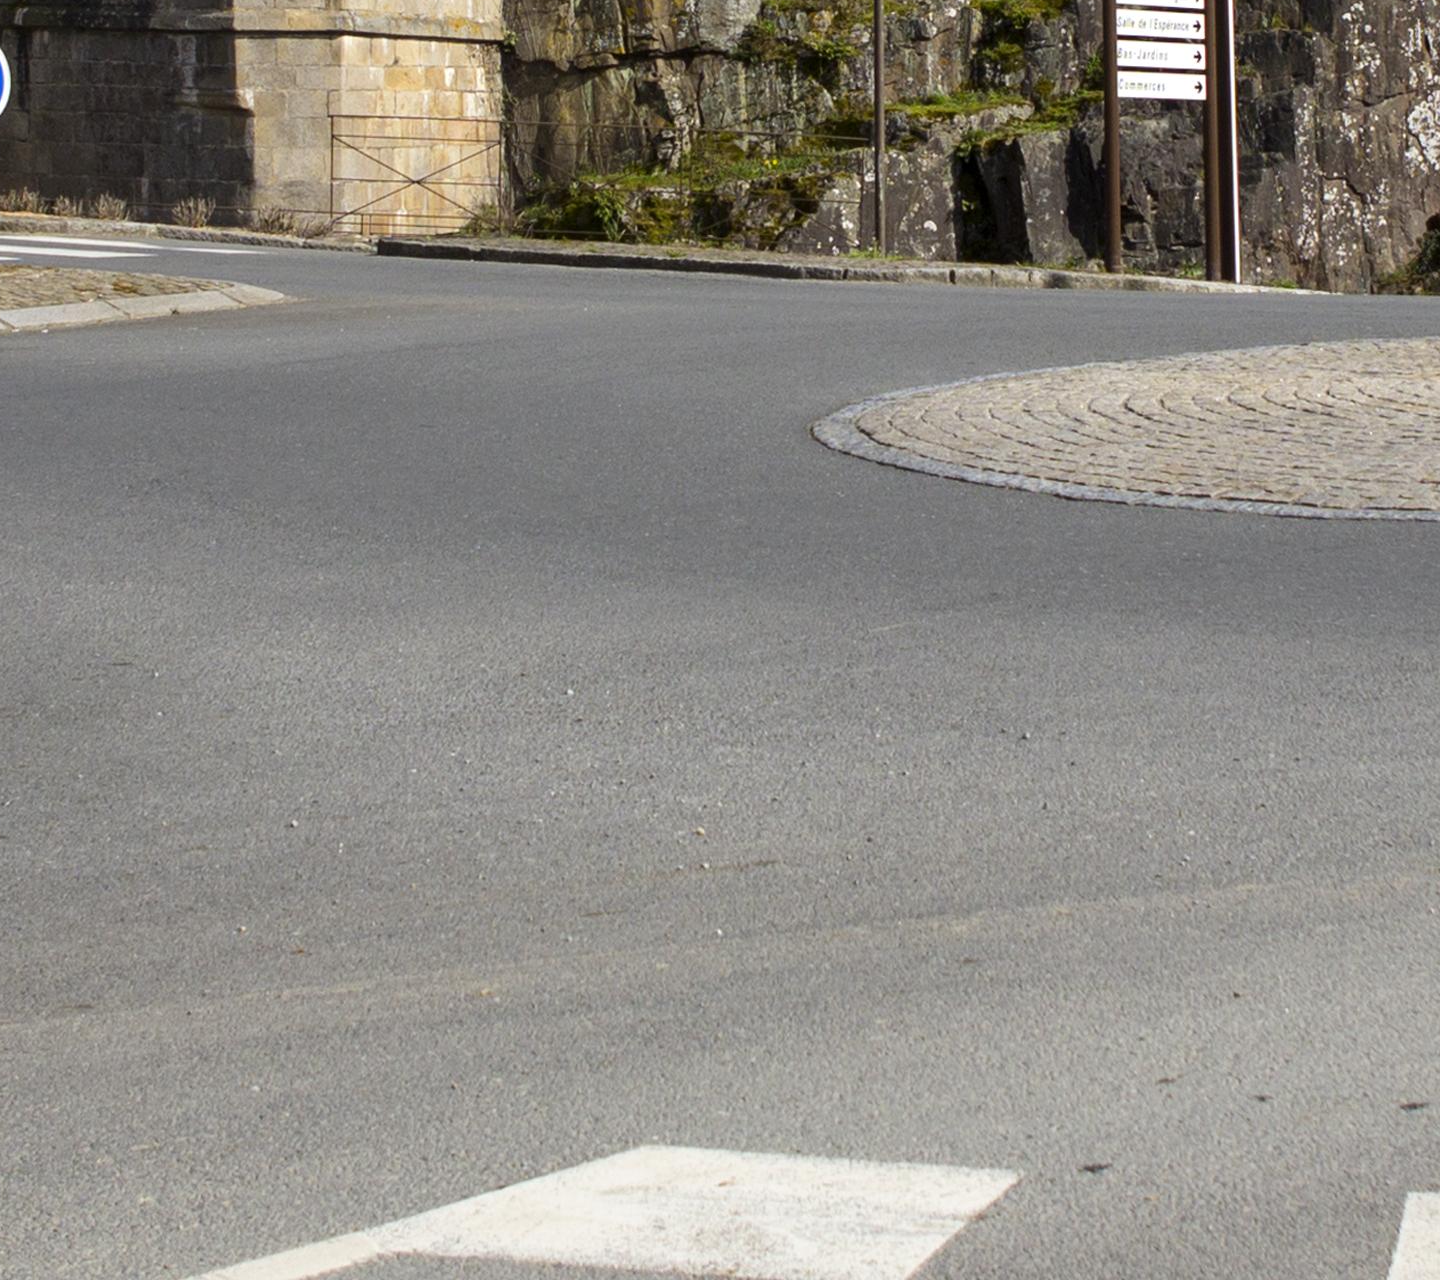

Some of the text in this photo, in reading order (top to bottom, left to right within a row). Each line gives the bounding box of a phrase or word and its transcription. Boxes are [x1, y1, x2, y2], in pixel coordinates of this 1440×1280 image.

[1117, 15, 1135, 28] Salle
[1138, 18, 1146, 29] de
[1117, 47, 1168, 61] Bas-Jardins
[1118, 78, 1165, 92] Commerces
